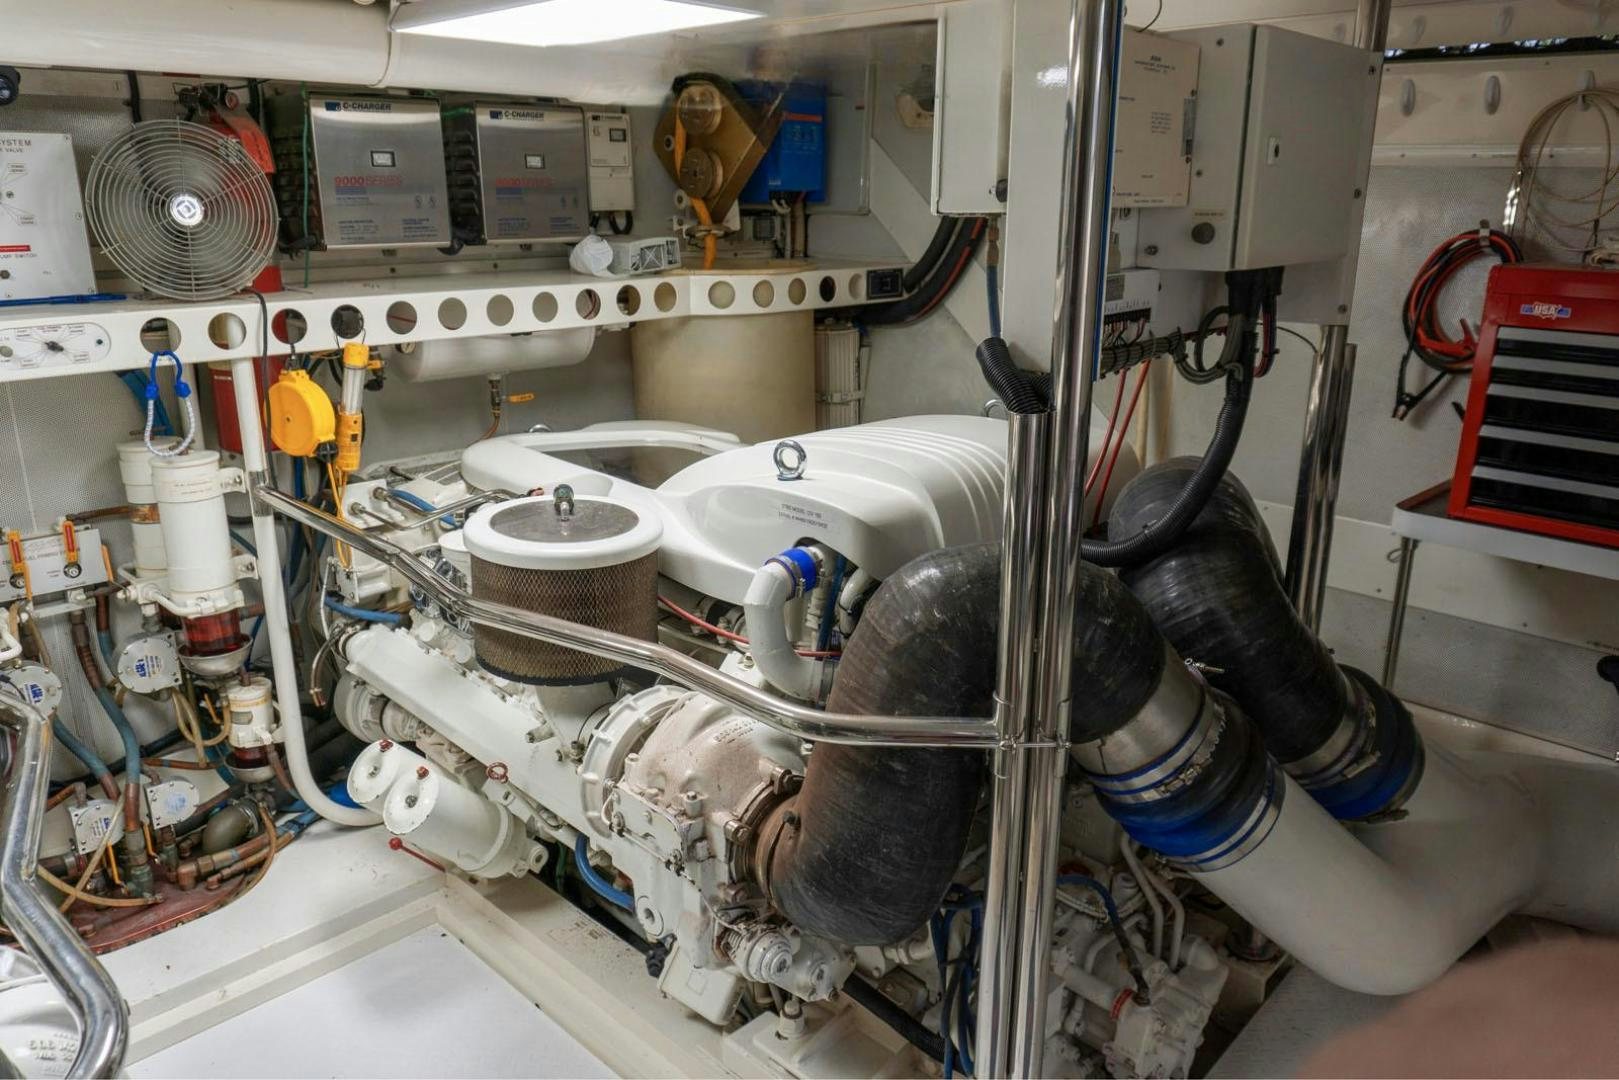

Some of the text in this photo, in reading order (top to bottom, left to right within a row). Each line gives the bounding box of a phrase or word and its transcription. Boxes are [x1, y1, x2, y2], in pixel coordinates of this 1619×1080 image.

[342, 101, 392, 111] C-CHARGER
[503, 110, 545, 119] C-CHARGER
[0, 139, 32, 147] YSTEM
